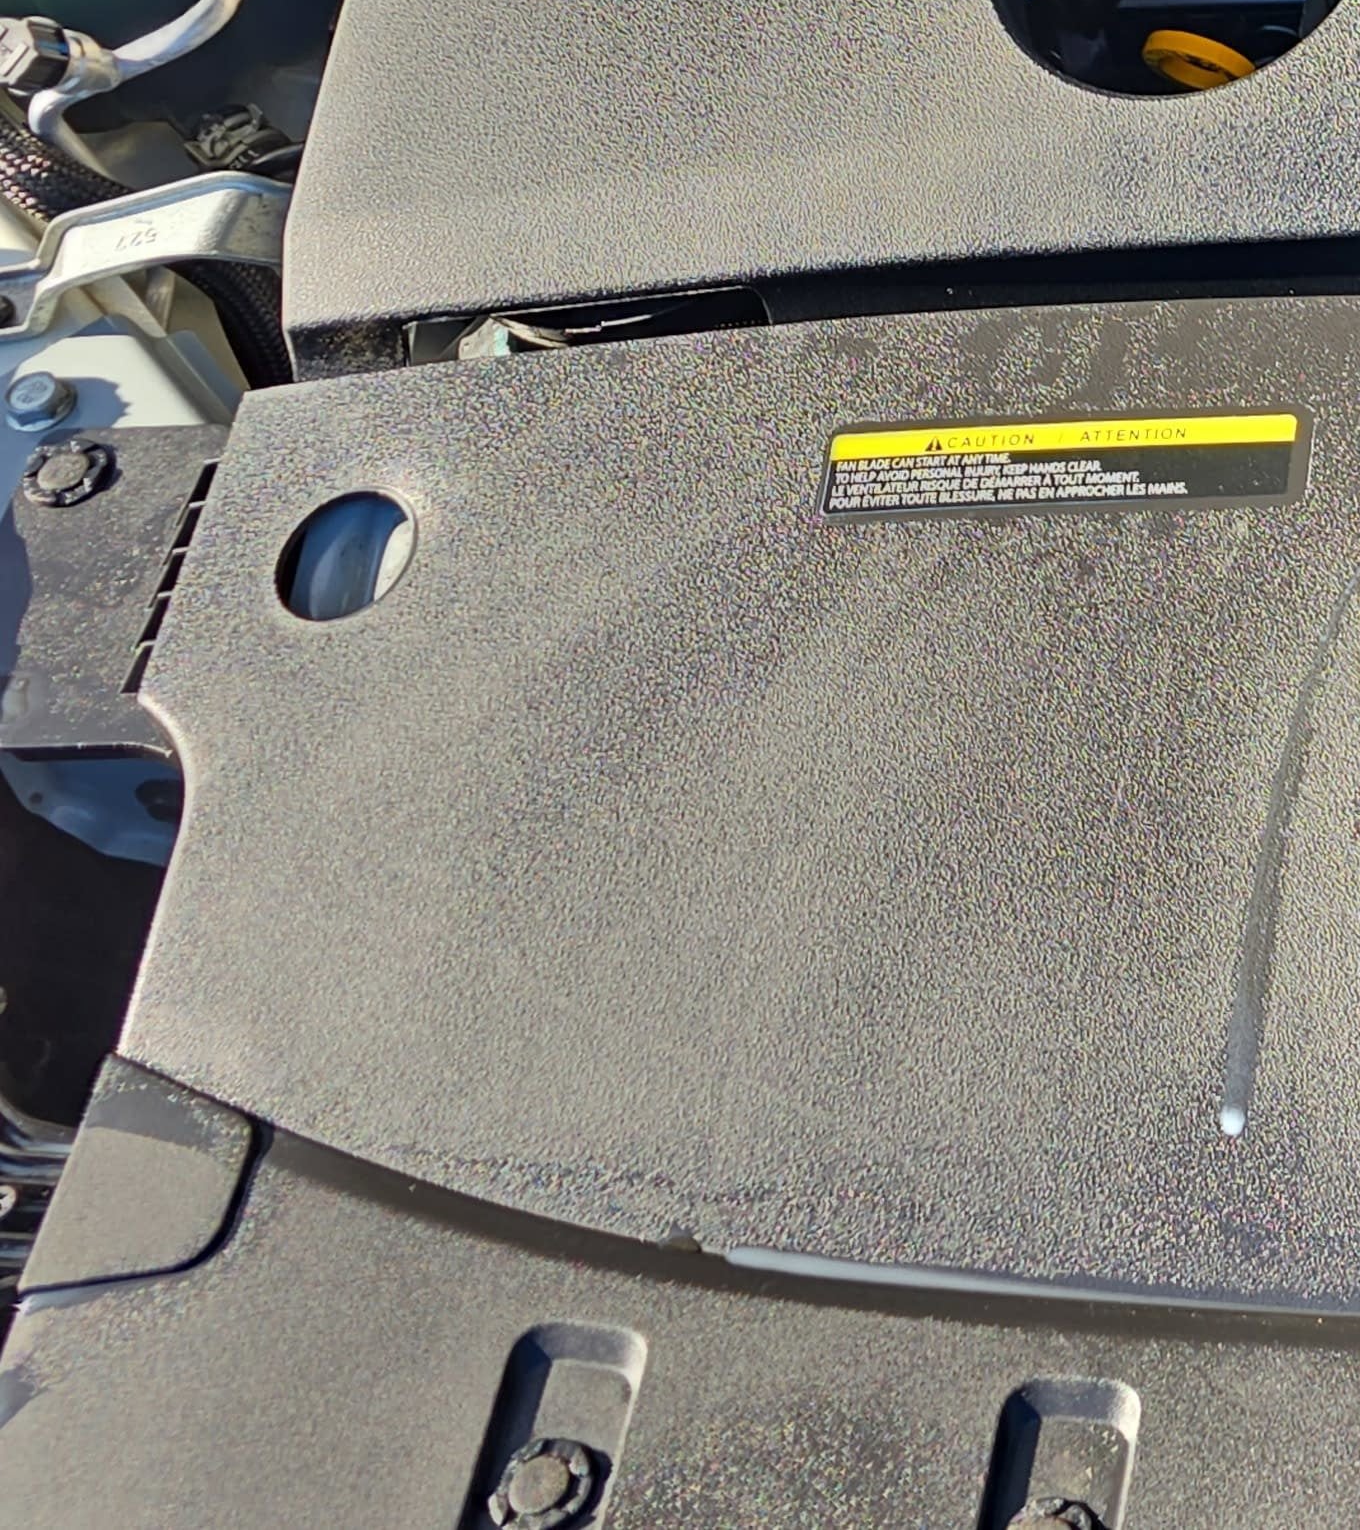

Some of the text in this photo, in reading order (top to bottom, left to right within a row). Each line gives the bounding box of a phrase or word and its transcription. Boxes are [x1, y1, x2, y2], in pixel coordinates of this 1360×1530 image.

[947, 434, 1034, 448] CAUTION
[1080, 428, 1186, 442] ATTENTION
[835, 472, 849, 484] TO
[851, 471, 877, 484] HELP
[877, 468, 910, 482] AVOID
[911, 466, 962, 481] PERSONAL
[1003, 463, 1028, 475] KEEP
[1029, 461, 1066, 474] HANDS
[1067, 460, 1102, 472] CLEAR.
[836, 461, 857, 472] FAN
[857, 458, 891, 471] BLADE
[892, 456, 914, 469] CAN
[915, 454, 947, 467] START
[947, 454, 960, 466] AT
[961, 453, 984, 466] ANY
[829, 497, 861, 510] POUR
[901, 491, 937, 505] TOUTE
[997, 488, 1014, 501] NE
[1015, 487, 1037, 500] PAS
[1038, 486, 1055, 499] EN
[1056, 483, 1124, 499] APPROCHER
[1126, 482, 1146, 496] LES
[1147, 481, 1188, 495] MAINS.
[832, 485, 845, 497] LE
[846, 480, 918, 496] VENTILATEUR
[920, 478, 960, 492] RISQUE
[963, 477, 978, 490] DE
[1054, 473, 1085, 486] TOUT
[1085, 471, 1140, 484] MOMENT.
